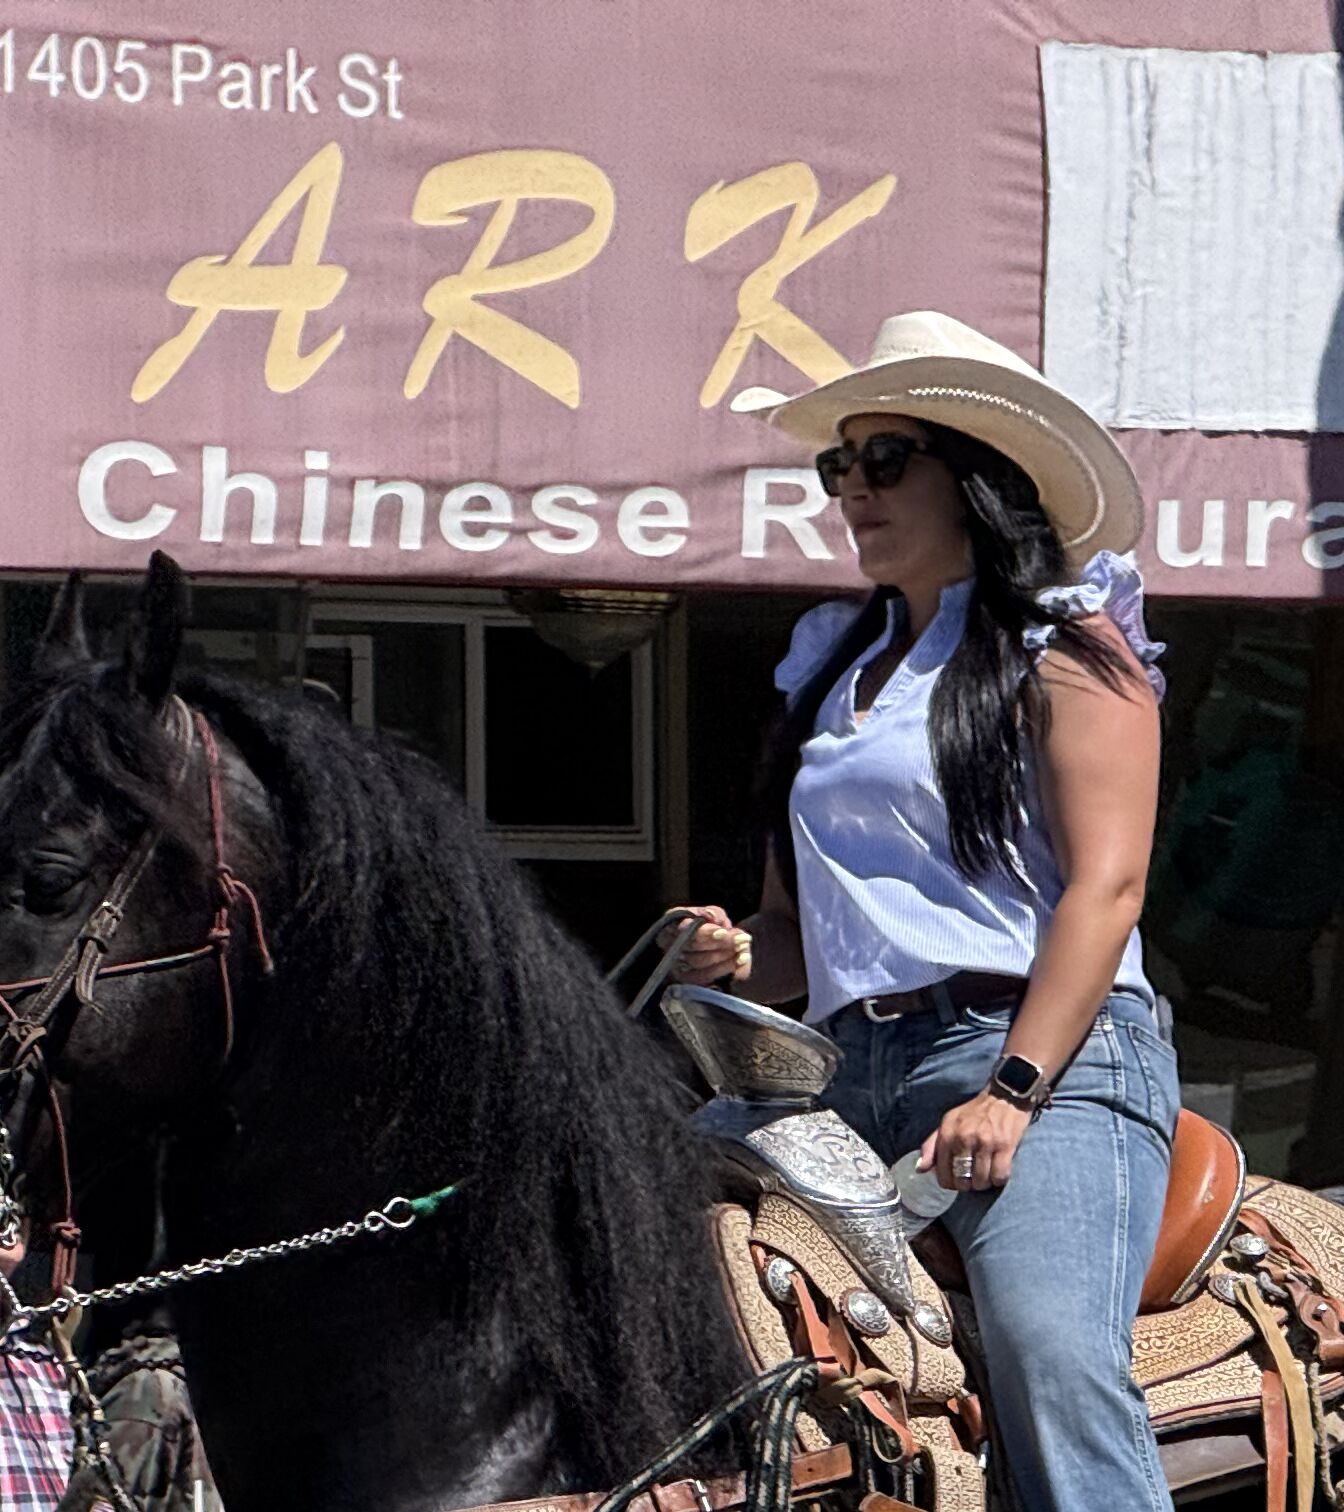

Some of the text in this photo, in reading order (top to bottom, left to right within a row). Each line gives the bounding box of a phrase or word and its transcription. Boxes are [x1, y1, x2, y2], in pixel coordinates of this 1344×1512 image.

[172, 42, 318, 114] Park
[337, 53, 404, 120] St
[131, 141, 897, 410] ARK
[77, 442, 690, 560] Chinese
